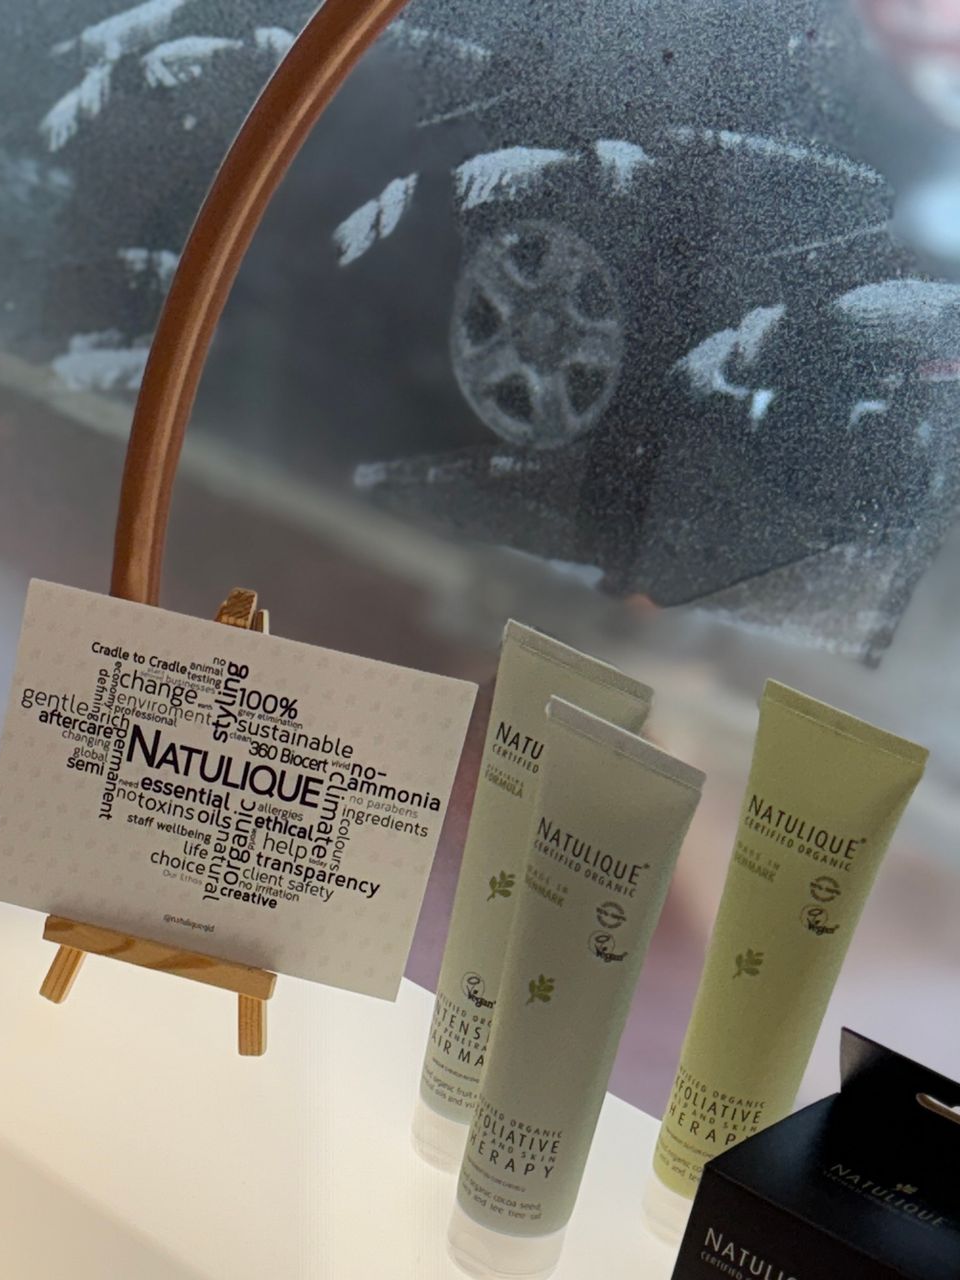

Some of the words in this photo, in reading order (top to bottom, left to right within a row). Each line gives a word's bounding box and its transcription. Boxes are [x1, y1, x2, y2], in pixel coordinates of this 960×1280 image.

[91, 641, 130, 661] Cradle
[133, 652, 145, 664] to
[149, 656, 188, 675] Cradle
[189, 661, 224, 677] animal
[213, 657, 226, 667] no
[87, 668, 110, 722] defining
[104, 661, 122, 710] economy
[120, 669, 198, 708] change
[187, 672, 222, 690] testing
[20, 688, 89, 717] gentle
[113, 705, 178, 728] professional
[117, 692, 213, 726] enviroment
[212, 661, 249, 743] styling
[239, 687, 298, 720] 100%
[38, 709, 113, 739] aftercare
[100, 711, 130, 730] rich
[257, 714, 304, 731] elimination
[61, 729, 111, 752] changing
[73, 746, 109, 763] global
[236, 719, 354, 759] sustainable
[66, 756, 105, 776] semi
[126, 723, 325, 809] NATULIQUE
[248, 740, 278, 761] 360
[279, 747, 329, 773] Biocert
[331, 759, 351, 771] vivid
[350, 763, 387, 780] no-
[98, 727, 128, 821] permanent
[140, 776, 231, 811] essential
[347, 776, 441, 812] ammonia
[349, 795, 363, 805] no
[366, 798, 419, 819] parabens
[197, 808, 232, 829] oils
[257, 802, 304, 822] allergies
[311, 771, 348, 860] climate
[341, 805, 429, 838] ingredients
[126, 813, 155, 828] staff
[156, 820, 212, 845] wellbeing
[223, 798, 256, 886] organic
[254, 815, 314, 841] ethical
[183, 840, 209, 860] life
[262, 831, 308, 863] help
[329, 818, 350, 872] colours
[744, 816, 795, 849] CERTIFIED
[797, 844, 852, 873] ORGANIC
[150, 850, 206, 875] choice
[202, 830, 230, 901] natural
[255, 851, 381, 898] transparency
[220, 886, 278, 909] creative
[238, 880, 253, 890] no
[255, 881, 300, 902] irritation
[242, 866, 284, 888] client
[286, 879, 335, 903] safety
[583, 868, 638, 898] ORGANIC
[700, 1250, 743, 1280] CERTIFIED
